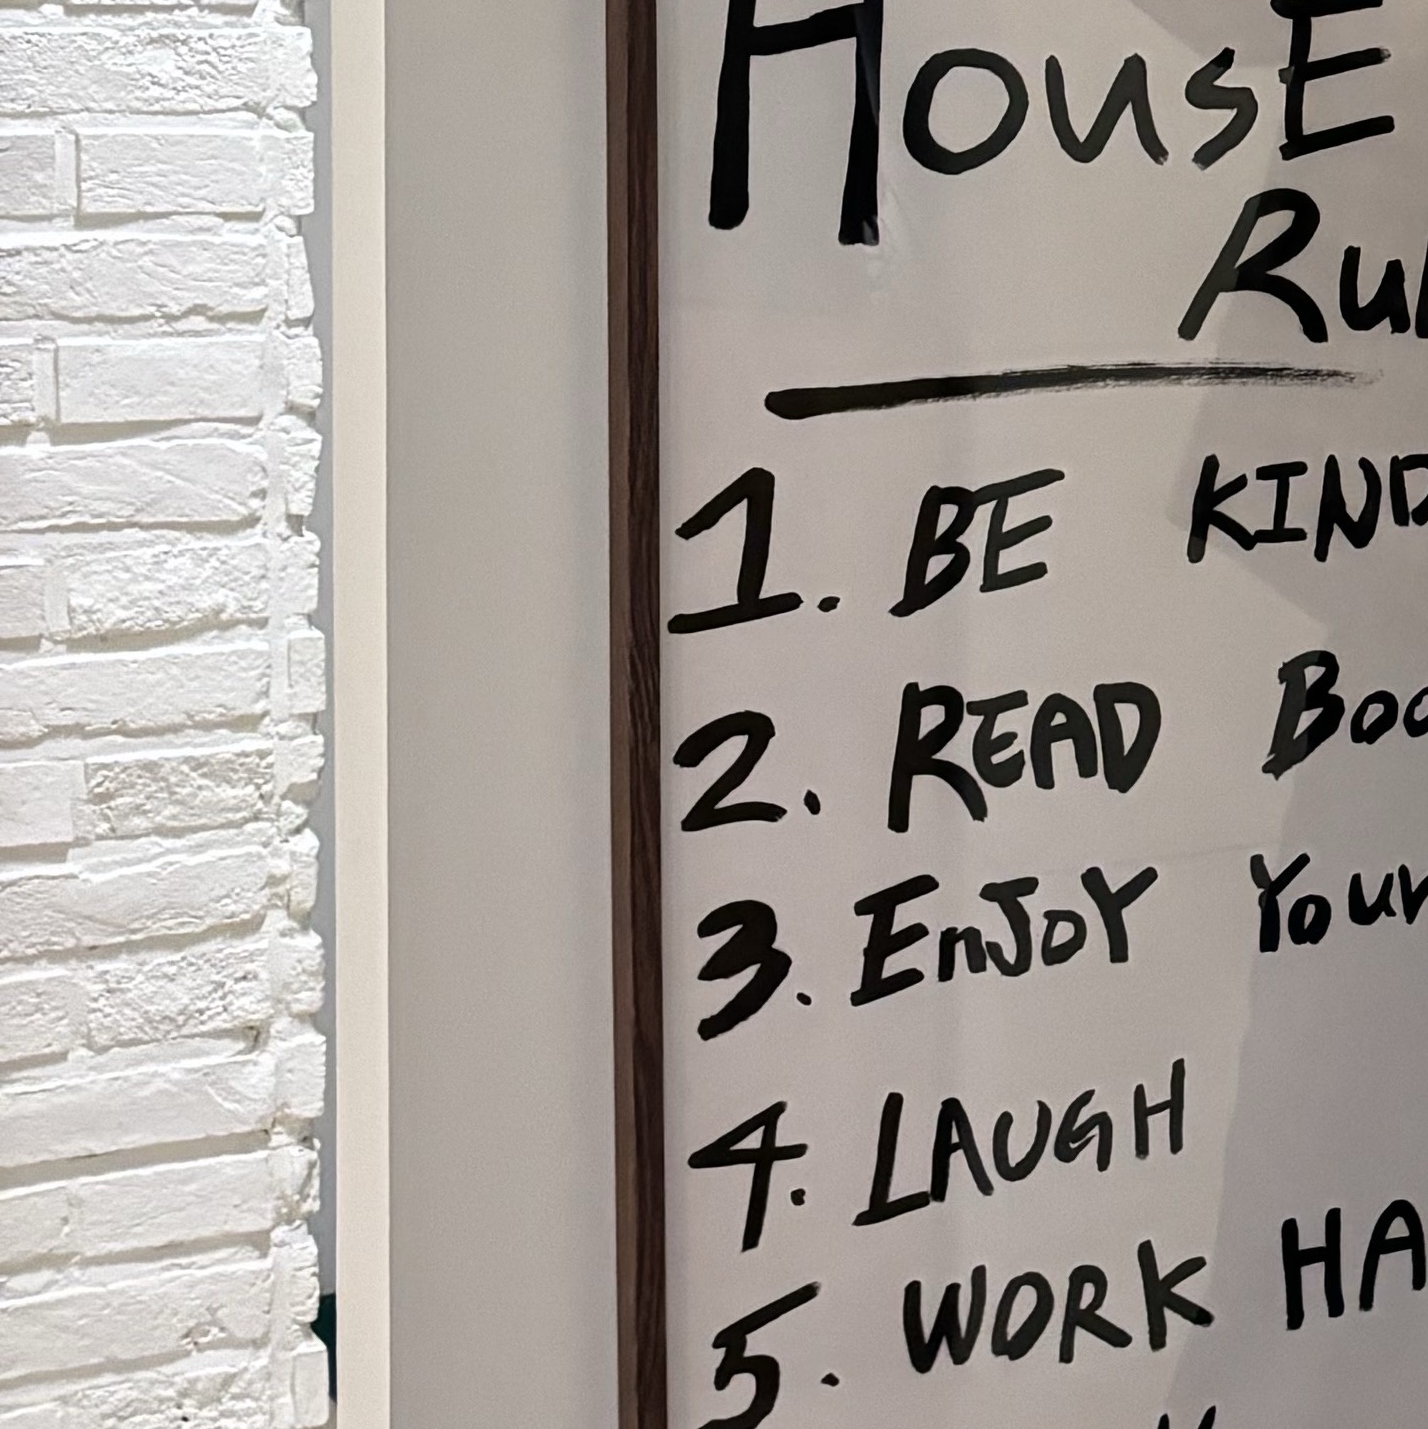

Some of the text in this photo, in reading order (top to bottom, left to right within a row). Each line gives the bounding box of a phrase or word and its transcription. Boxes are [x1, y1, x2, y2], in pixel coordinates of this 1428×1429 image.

[667, 467, 842, 634] 1.
[889, 468, 1066, 618] BE
[672, 710, 821, 833] 2.
[888, 681, 1162, 834] READ
[696, 899, 813, 1042] 3.
[686, 1058, 1186, 1253] 4. LAUGH
[902, 1239, 1215, 1375] WORK
